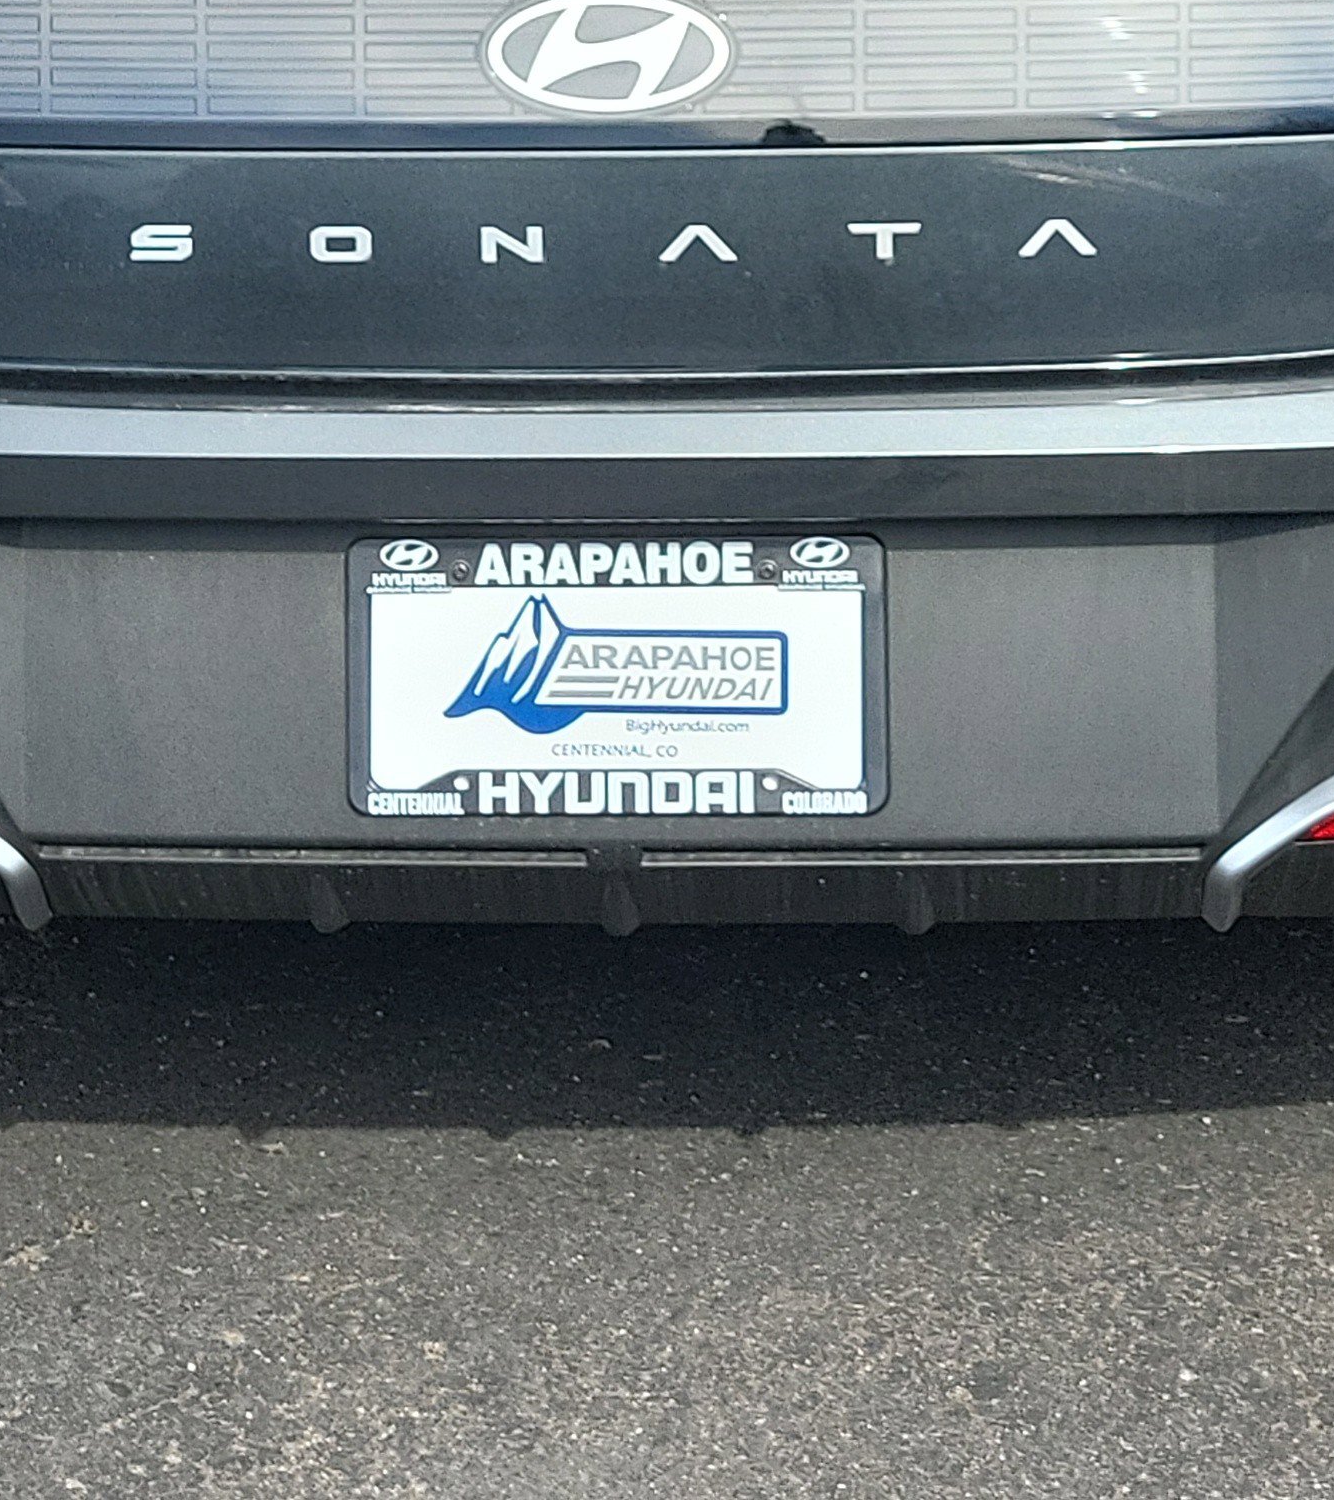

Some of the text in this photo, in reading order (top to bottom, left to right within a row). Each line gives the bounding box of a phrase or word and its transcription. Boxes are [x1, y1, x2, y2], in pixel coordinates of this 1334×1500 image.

[129, 218, 1097, 264] SONATA
[474, 541, 754, 586] ARAPAHOE
[560, 644, 776, 671] ARAPAHOE
[617, 676, 773, 701] HYUNDAI
[625, 718, 750, 735] BigHyundai.com
[656, 744, 679, 758] CO
[478, 770, 755, 815] HYUNDAI
[781, 790, 868, 815] COLORADO
